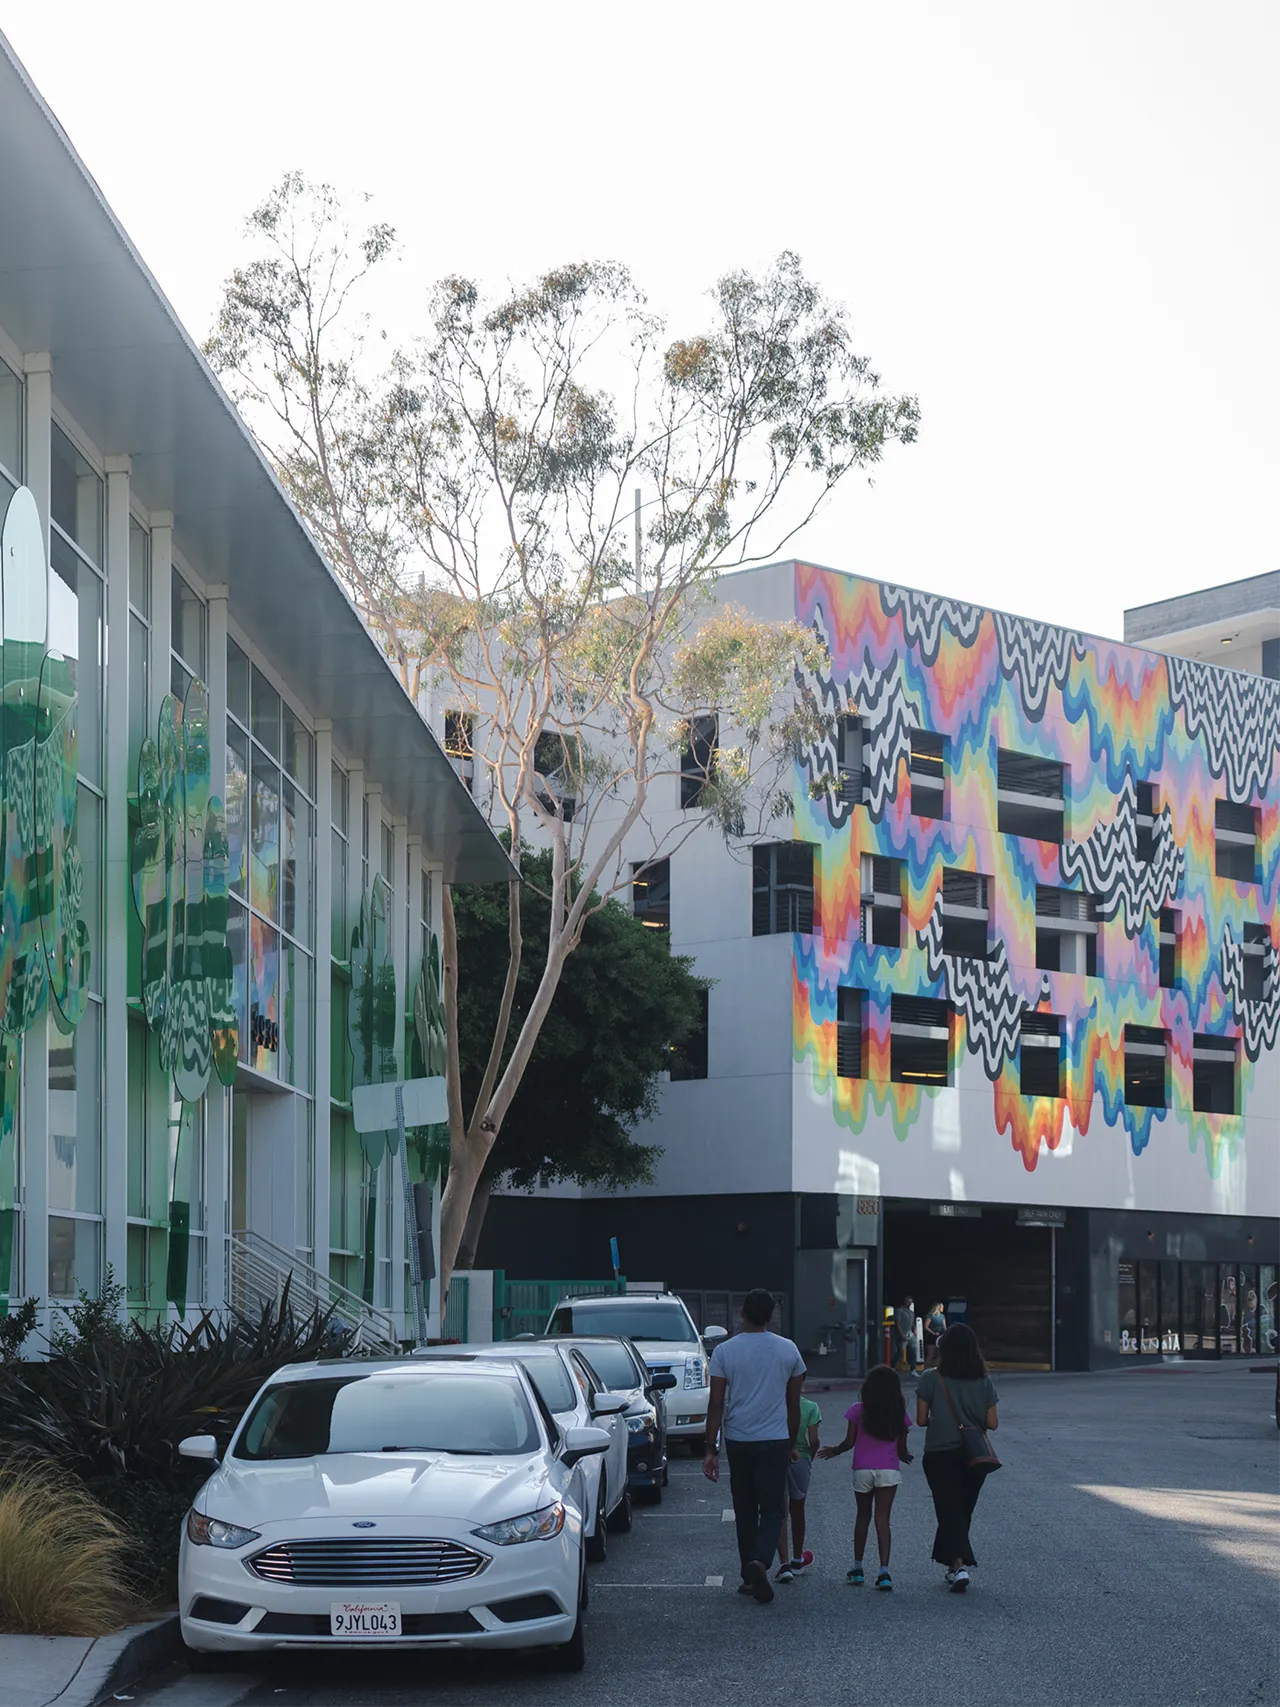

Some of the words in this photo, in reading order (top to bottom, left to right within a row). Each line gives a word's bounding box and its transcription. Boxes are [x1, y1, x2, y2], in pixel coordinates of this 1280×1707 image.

[943, 1204, 954, 1213] EXIT
[345, 1604, 387, 1614] California
[336, 1614, 397, 1630] 9JYL043
